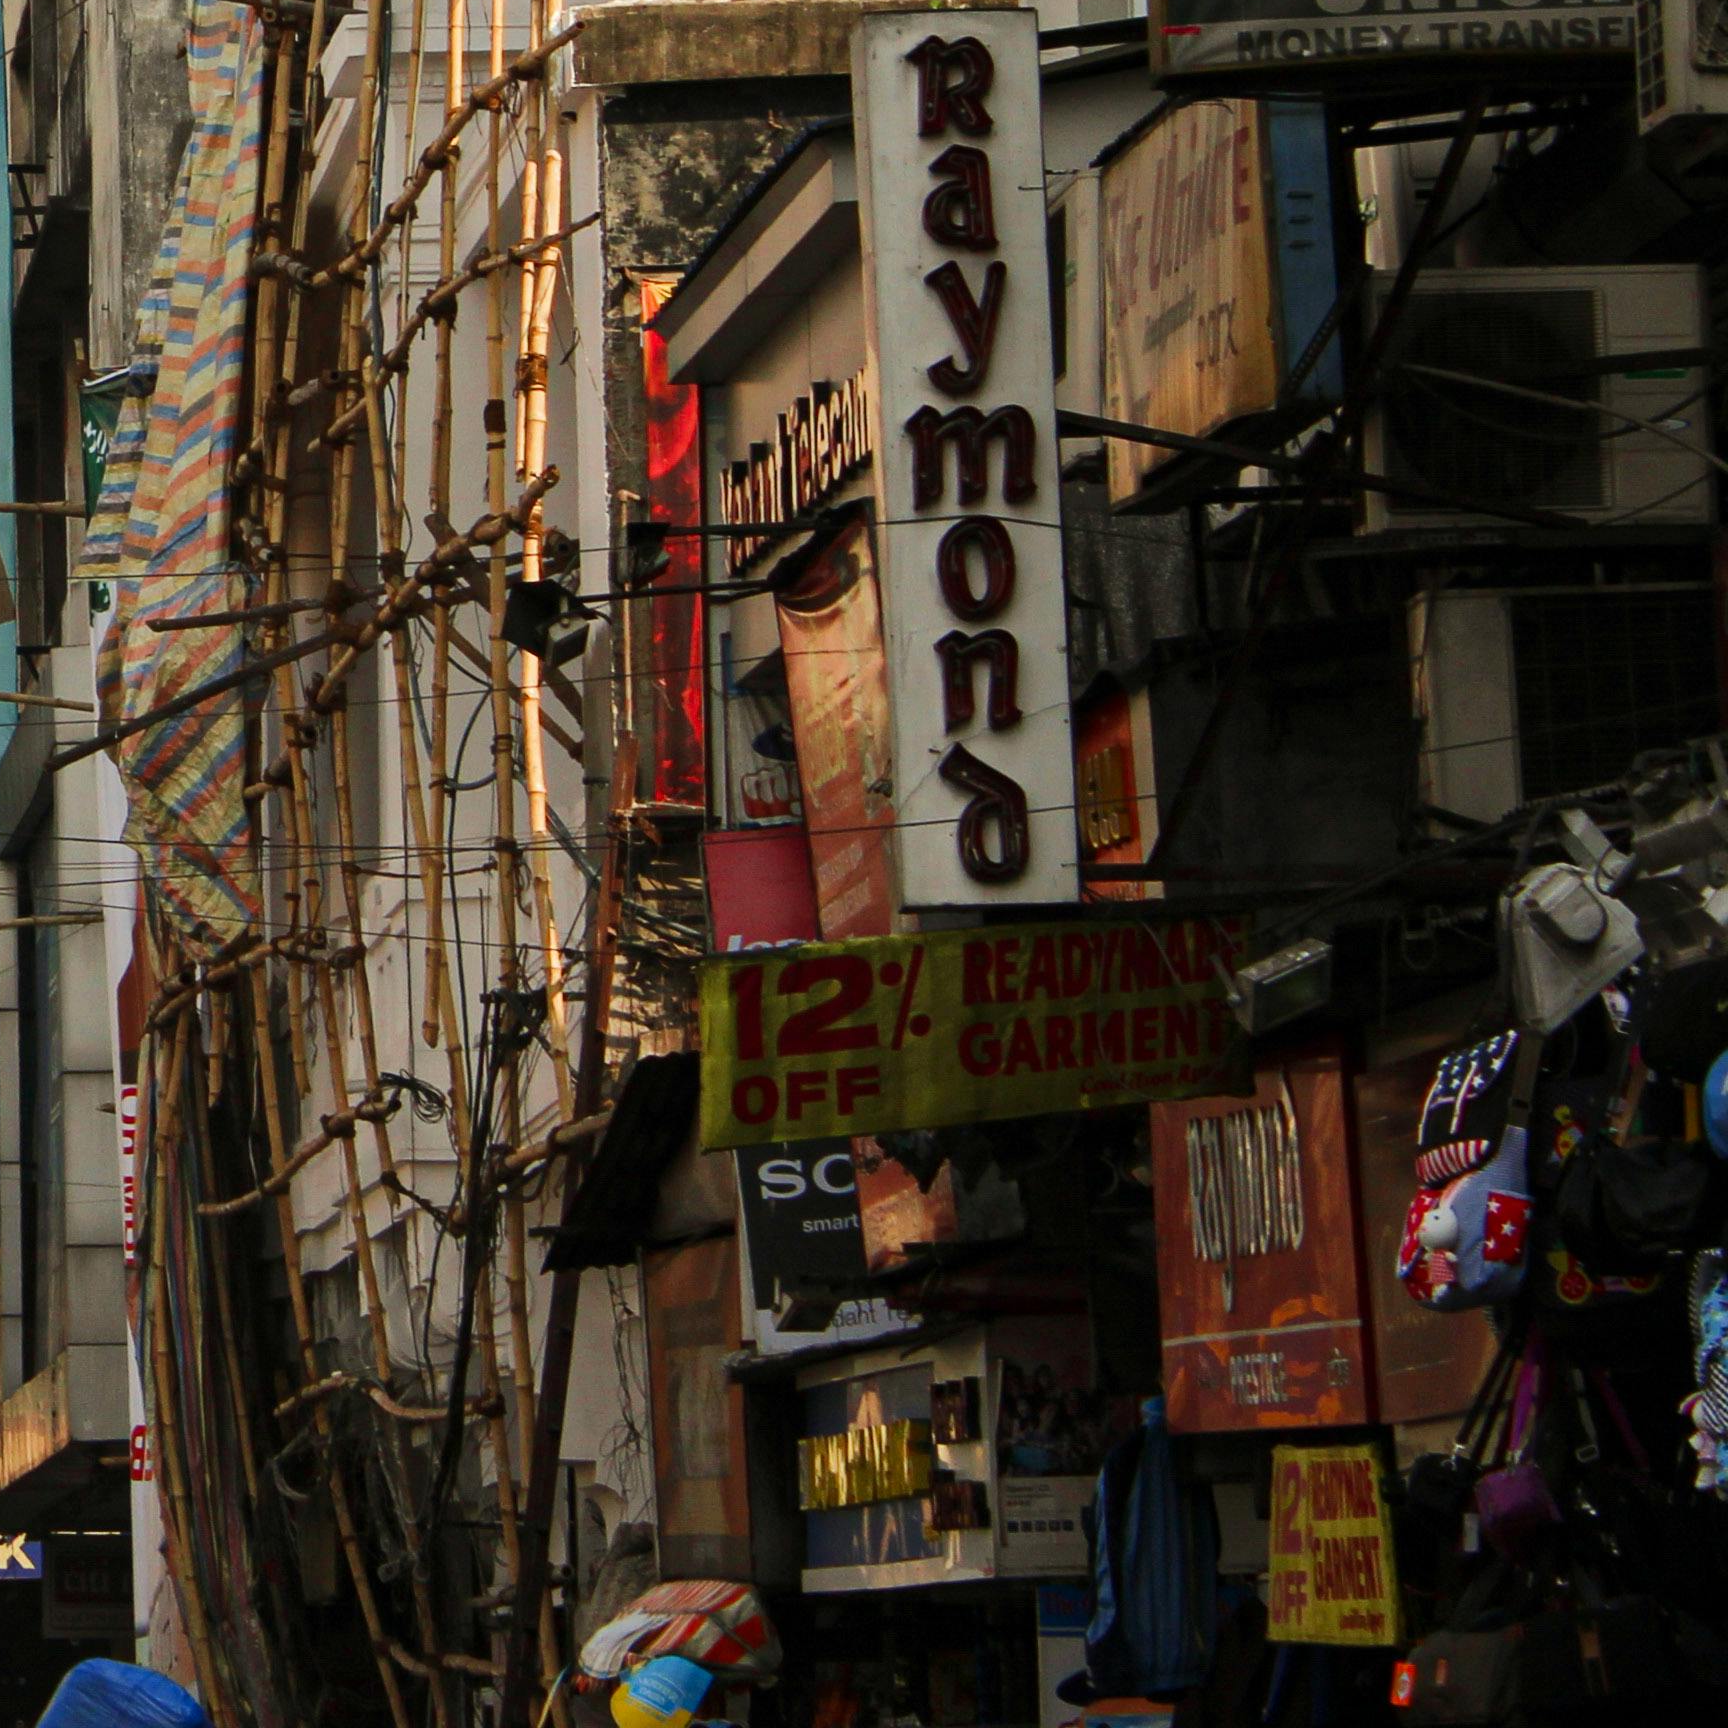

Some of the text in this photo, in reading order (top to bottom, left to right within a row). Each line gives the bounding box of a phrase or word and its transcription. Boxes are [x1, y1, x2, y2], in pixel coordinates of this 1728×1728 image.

[1234, 15, 1635, 64] MONEY TRANSF
[732, 917, 1243, 1062] 12% READYMADE
[732, 1064, 882, 1123] OFF
[1271, 1570, 1308, 1626] OFF
